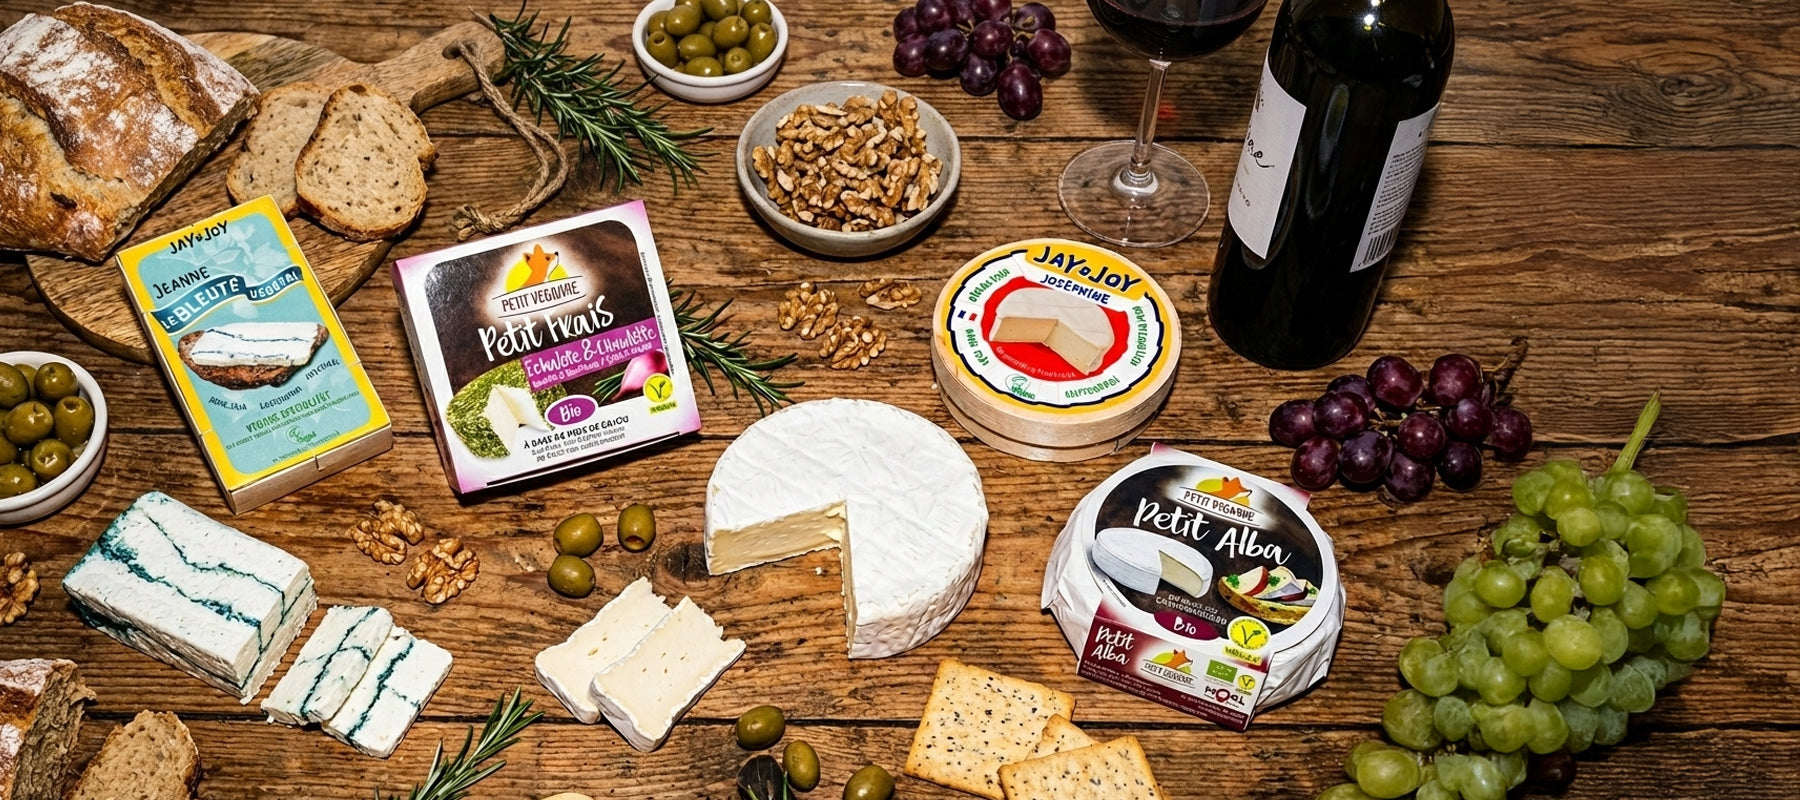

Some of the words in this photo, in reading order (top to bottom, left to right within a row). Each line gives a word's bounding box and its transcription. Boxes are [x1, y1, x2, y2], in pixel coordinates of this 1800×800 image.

[152, 265, 211, 300] JEANNE
[478, 318, 544, 362] Petit
[1132, 496, 1211, 541] Petit
[1214, 525, 1292, 566] Alba
[1091, 642, 1130, 666] Alba
